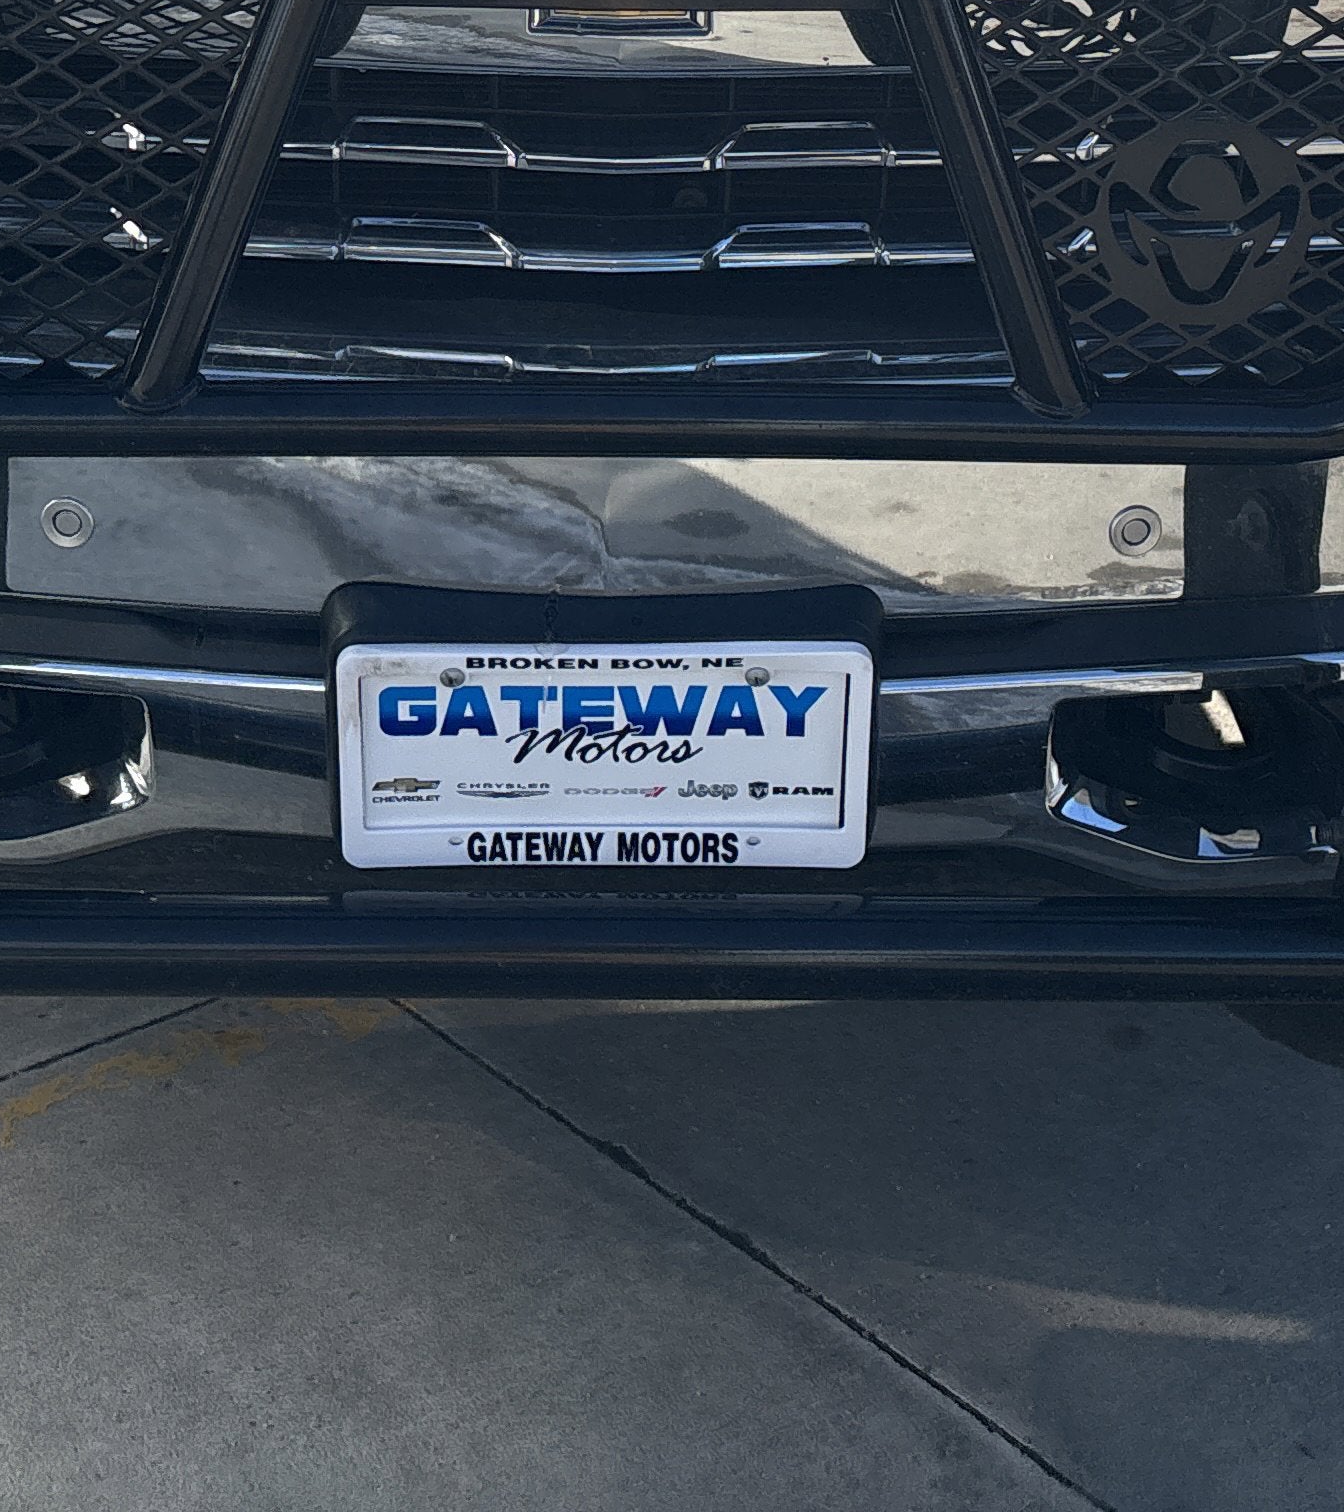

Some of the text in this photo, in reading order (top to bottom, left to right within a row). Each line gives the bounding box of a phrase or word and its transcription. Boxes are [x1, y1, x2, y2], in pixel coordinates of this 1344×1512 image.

[466, 657, 744, 670] BROKEN BOW, NE
[378, 685, 828, 737] GATEWAY
[505, 723, 703, 764] Motors
[372, 795, 440, 804] CHEVROLET
[678, 780, 738, 800] Jeep
[772, 786, 834, 796] RAM
[467, 831, 739, 864] GATEWAY MOTORS
